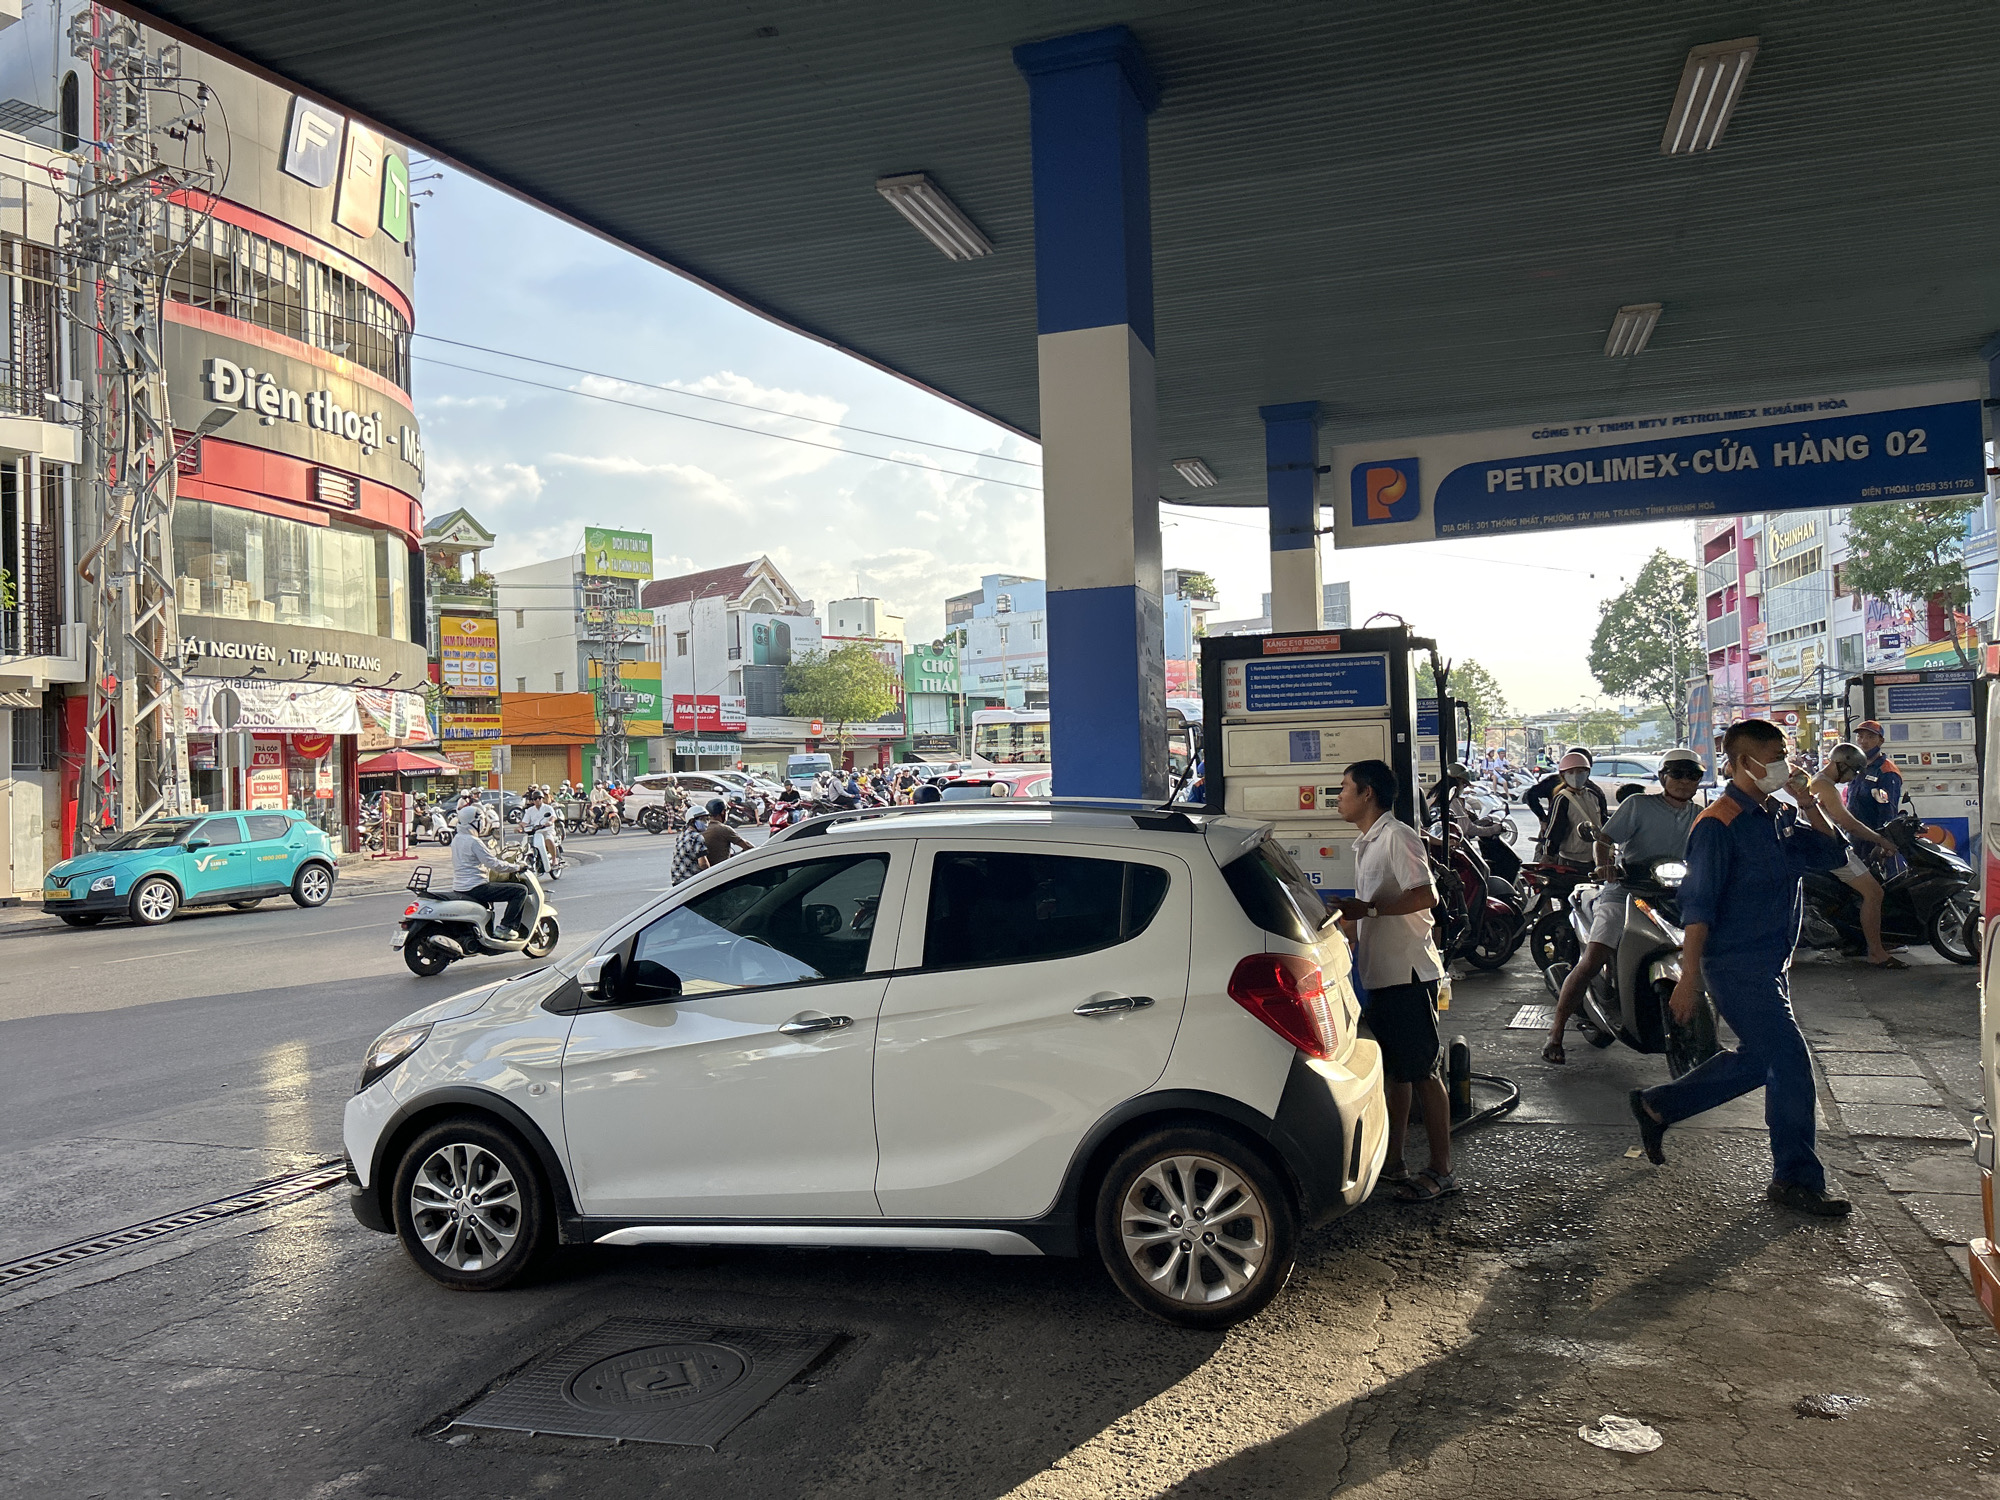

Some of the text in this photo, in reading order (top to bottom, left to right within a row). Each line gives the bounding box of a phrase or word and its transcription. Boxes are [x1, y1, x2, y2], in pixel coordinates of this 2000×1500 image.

[297, 110, 405, 219] FPT
[208, 356, 302, 427] Điện
[308, 390, 384, 457] thoại
[1532, 397, 1848, 440] CÔNG TY TNHH MTV PETROLIMEX KHÁNH HÒA
[1773, 433, 1870, 468] HÀNG
[1885, 428, 1928, 459] 02
[1915, 482, 1936, 492] 0258
[1938, 481, 1953, 491] 351
[1442, 524, 1455, 534] ĐỊA
[1476, 521, 1489, 529] 301
[1490, 516, 1517, 529] THỐNG
[1543, 511, 1574, 524] PHƯỜNG
[1593, 509, 1610, 519] NHA
[1780, 520, 1815, 550] SHINHAN
[465, 636, 496, 648] COMPUTER
[211, 640, 276, 662] NGUYÊN
[315, 650, 341, 668] NHA
[344, 653, 381, 672] TRANG
[922, 657, 954, 679] CHỢ
[919, 675, 957, 693] THÁI
[444, 726, 460, 740] MÁY
[460, 726, 475, 740] TÍNH
[479, 728, 502, 740] LAPTOP
[258, 753, 275, 765] 0%
[266, 743, 278, 753] GÓP
[1966, 800, 1979, 808] 04
